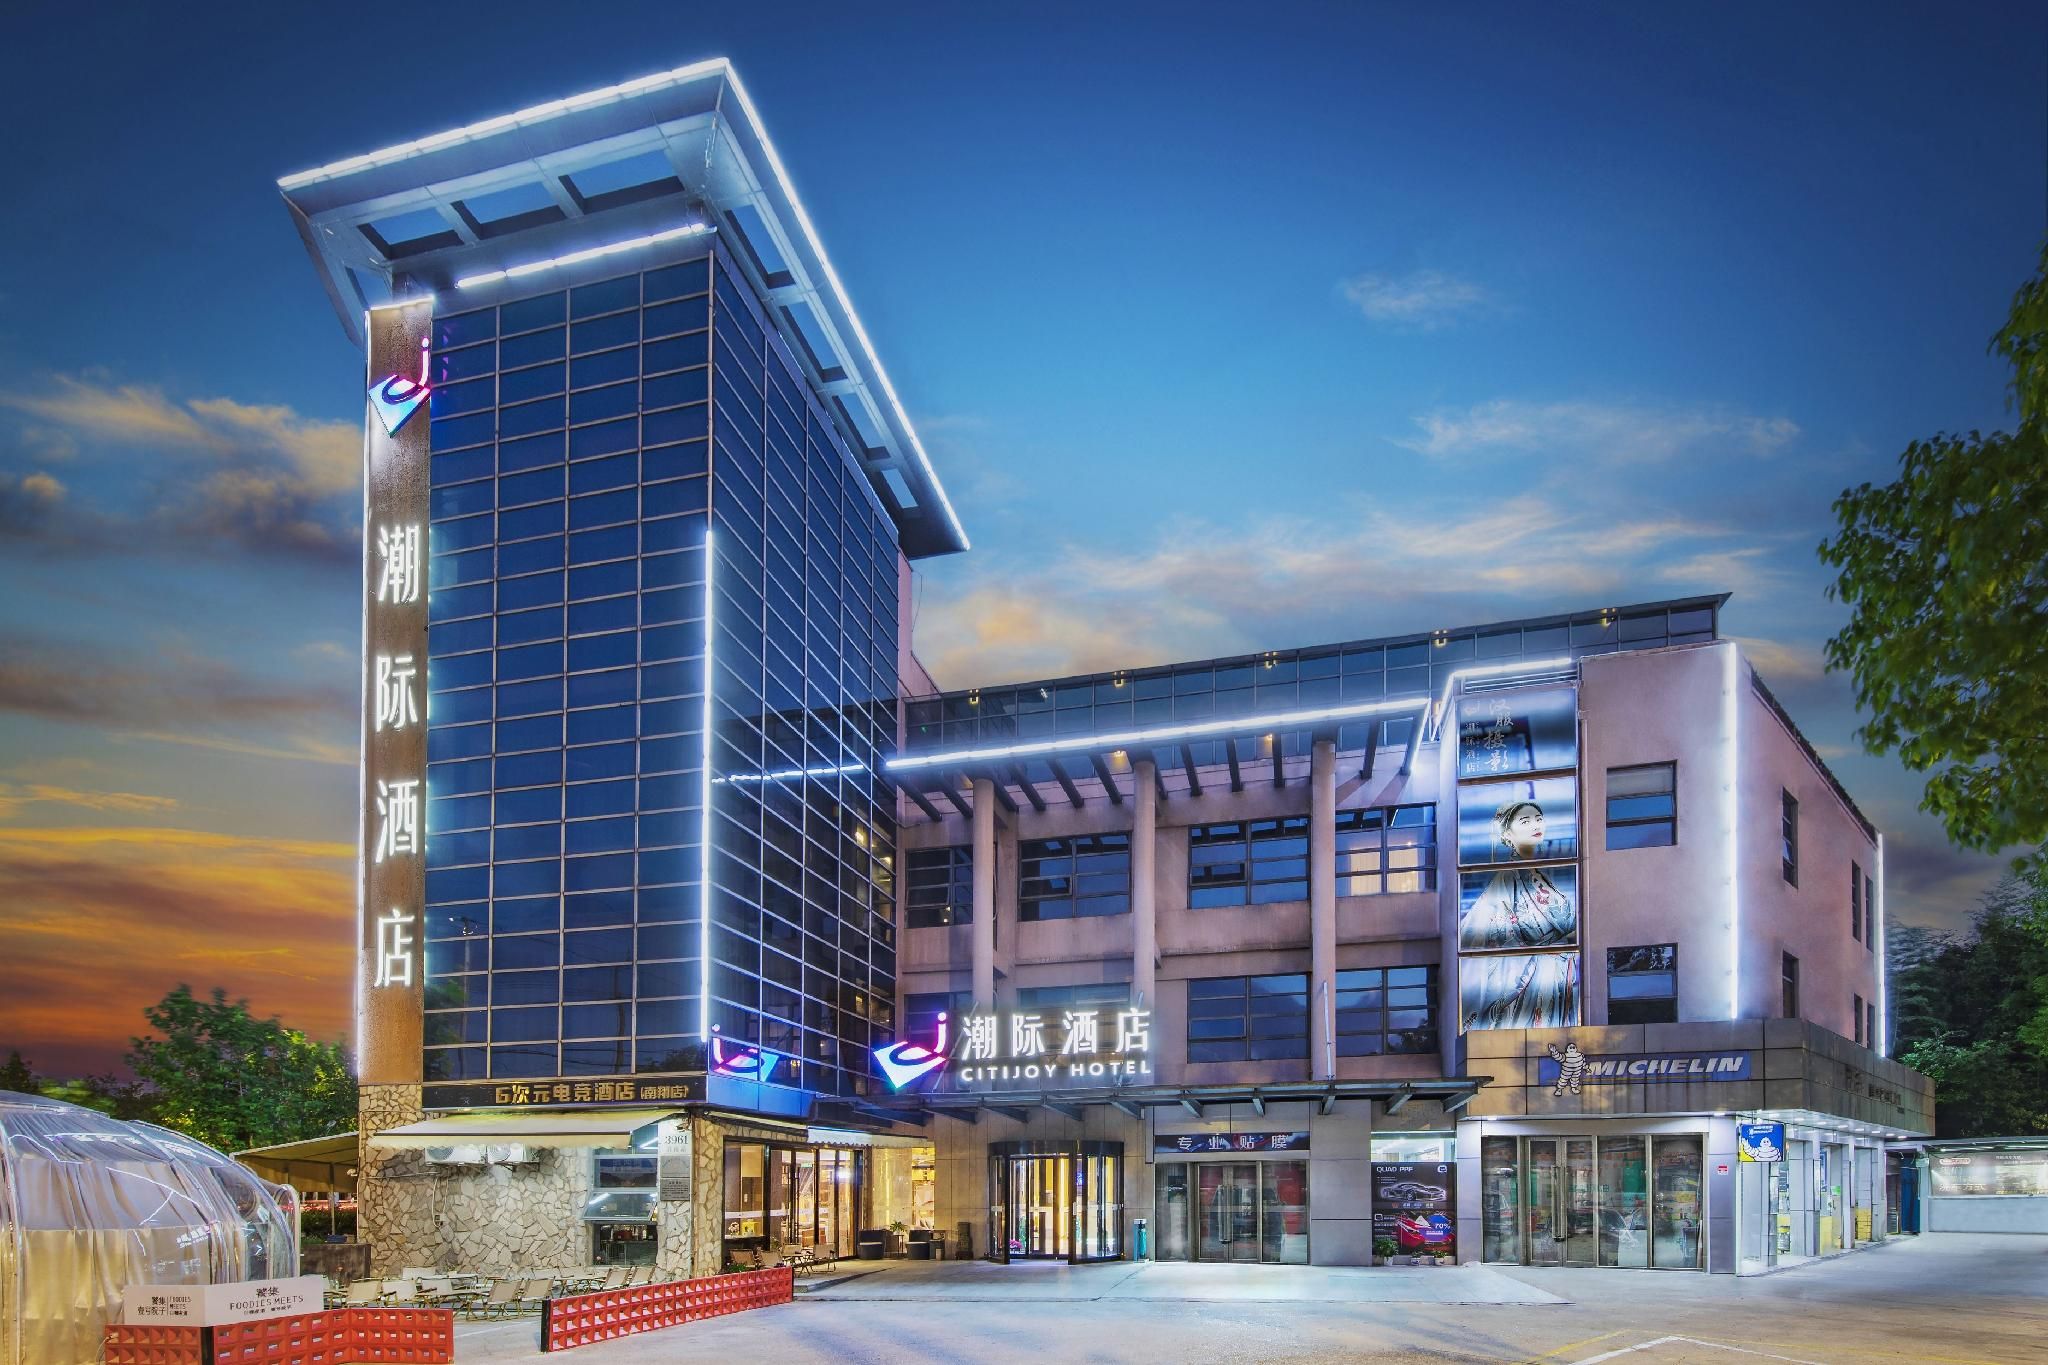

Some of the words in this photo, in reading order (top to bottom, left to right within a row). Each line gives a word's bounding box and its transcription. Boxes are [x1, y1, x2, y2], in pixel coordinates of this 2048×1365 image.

[374, 525, 422, 987] 潮际酒店
[961, 1008, 1151, 1061] 潮际酒店
[961, 1064, 1057, 1082] CITIJOY
[1071, 1060, 1151, 1077] HOTEL
[1589, 1056, 1743, 1076] MICHELIN
[665, 1135, 688, 1145] 3961
[1177, 1135, 1289, 1151] 专业贴膜
[229, 1298, 272, 1311] FOODIES
[274, 1294, 305, 1305] MEETS
